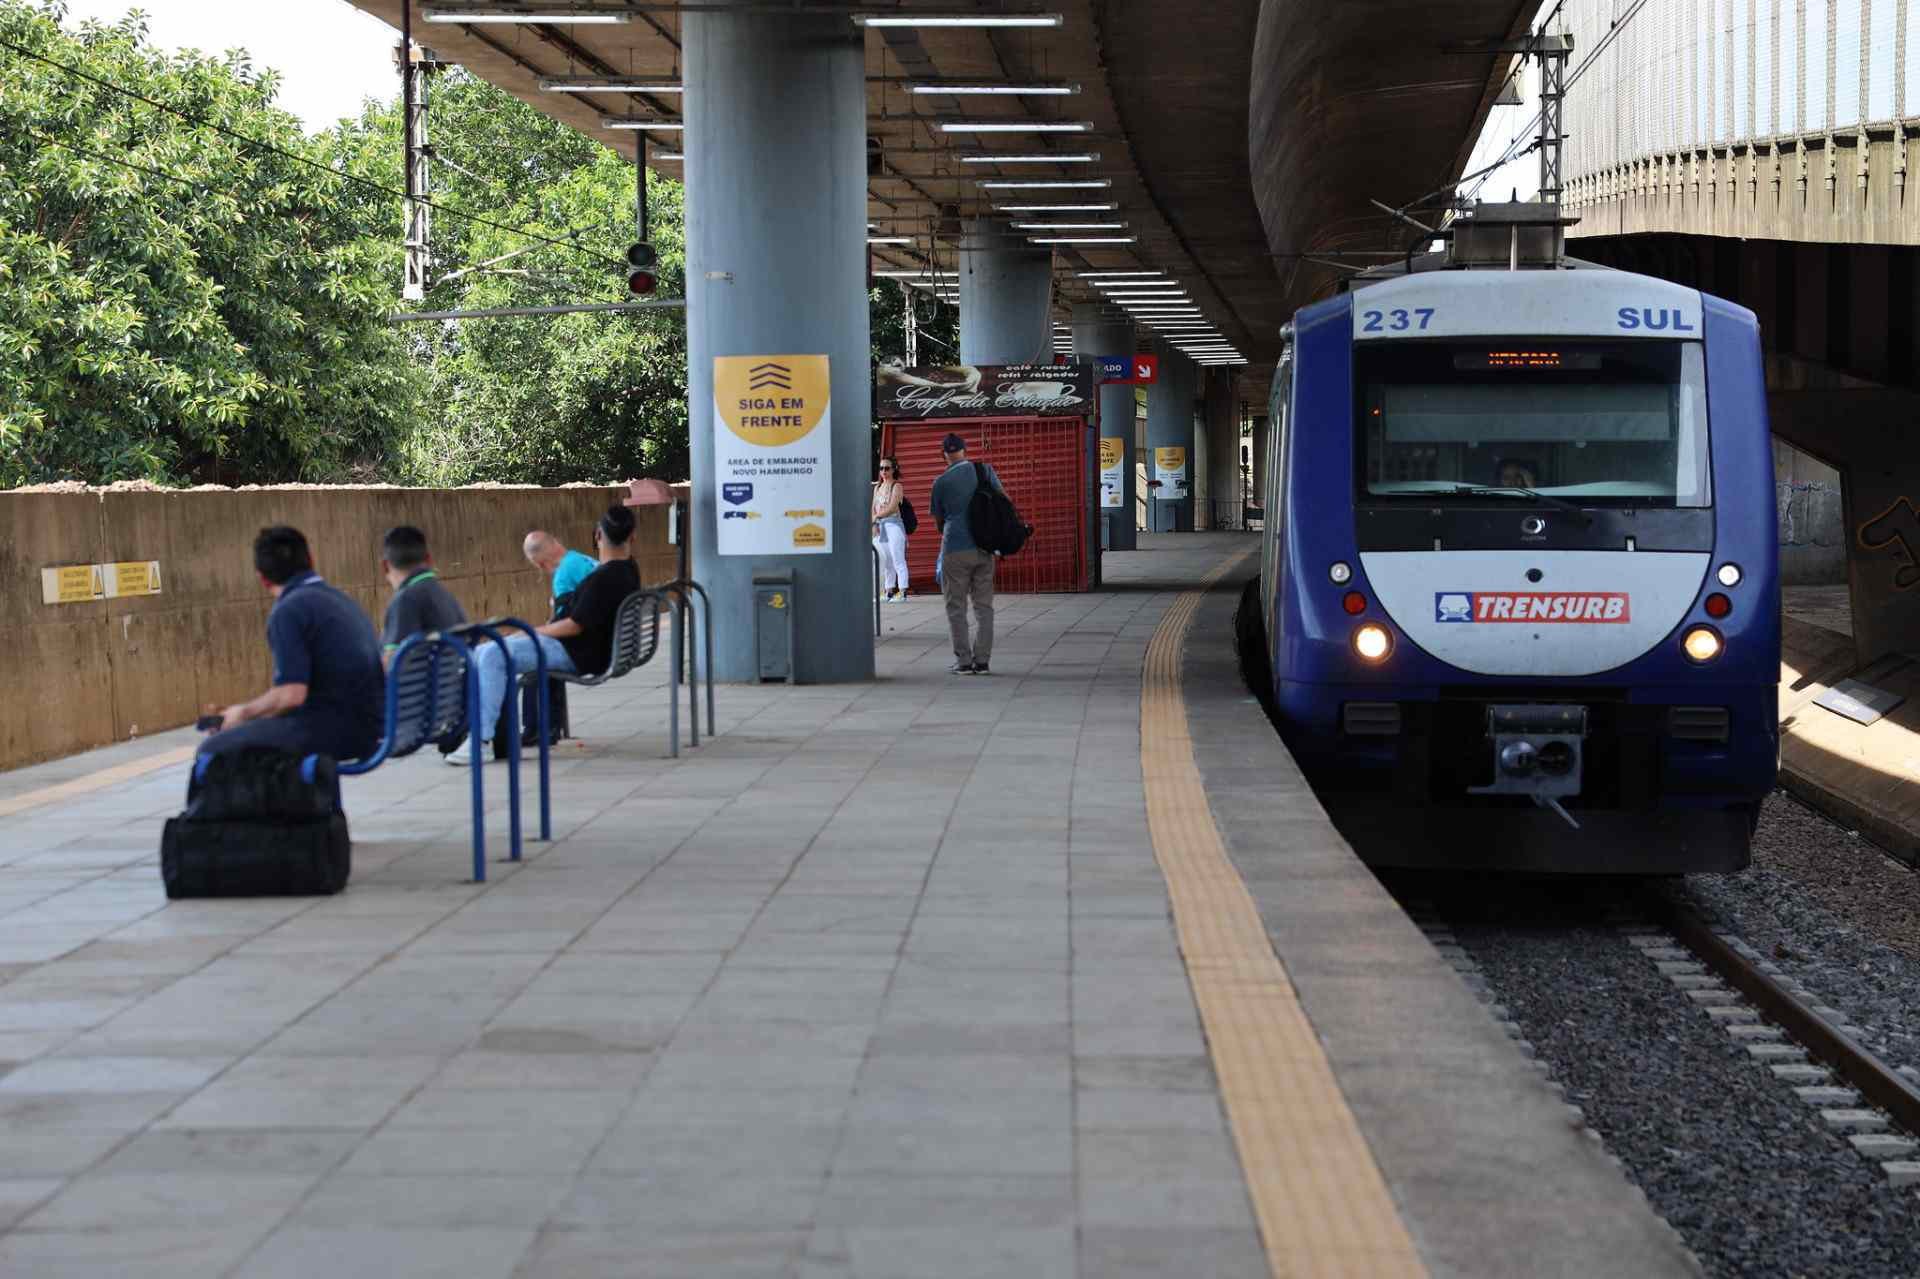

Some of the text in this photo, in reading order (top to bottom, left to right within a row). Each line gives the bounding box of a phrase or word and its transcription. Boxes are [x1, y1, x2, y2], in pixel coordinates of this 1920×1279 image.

[1363, 307, 1694, 332] 237 SUL
[739, 397, 804, 410] SIGA EM
[741, 415, 803, 428] FRENTE
[752, 457, 765, 466] DE
[767, 456, 818, 466] EMBARQUE
[732, 466, 813, 476] NOVO HAMBURGO
[1478, 595, 1625, 620] TRENSURB
